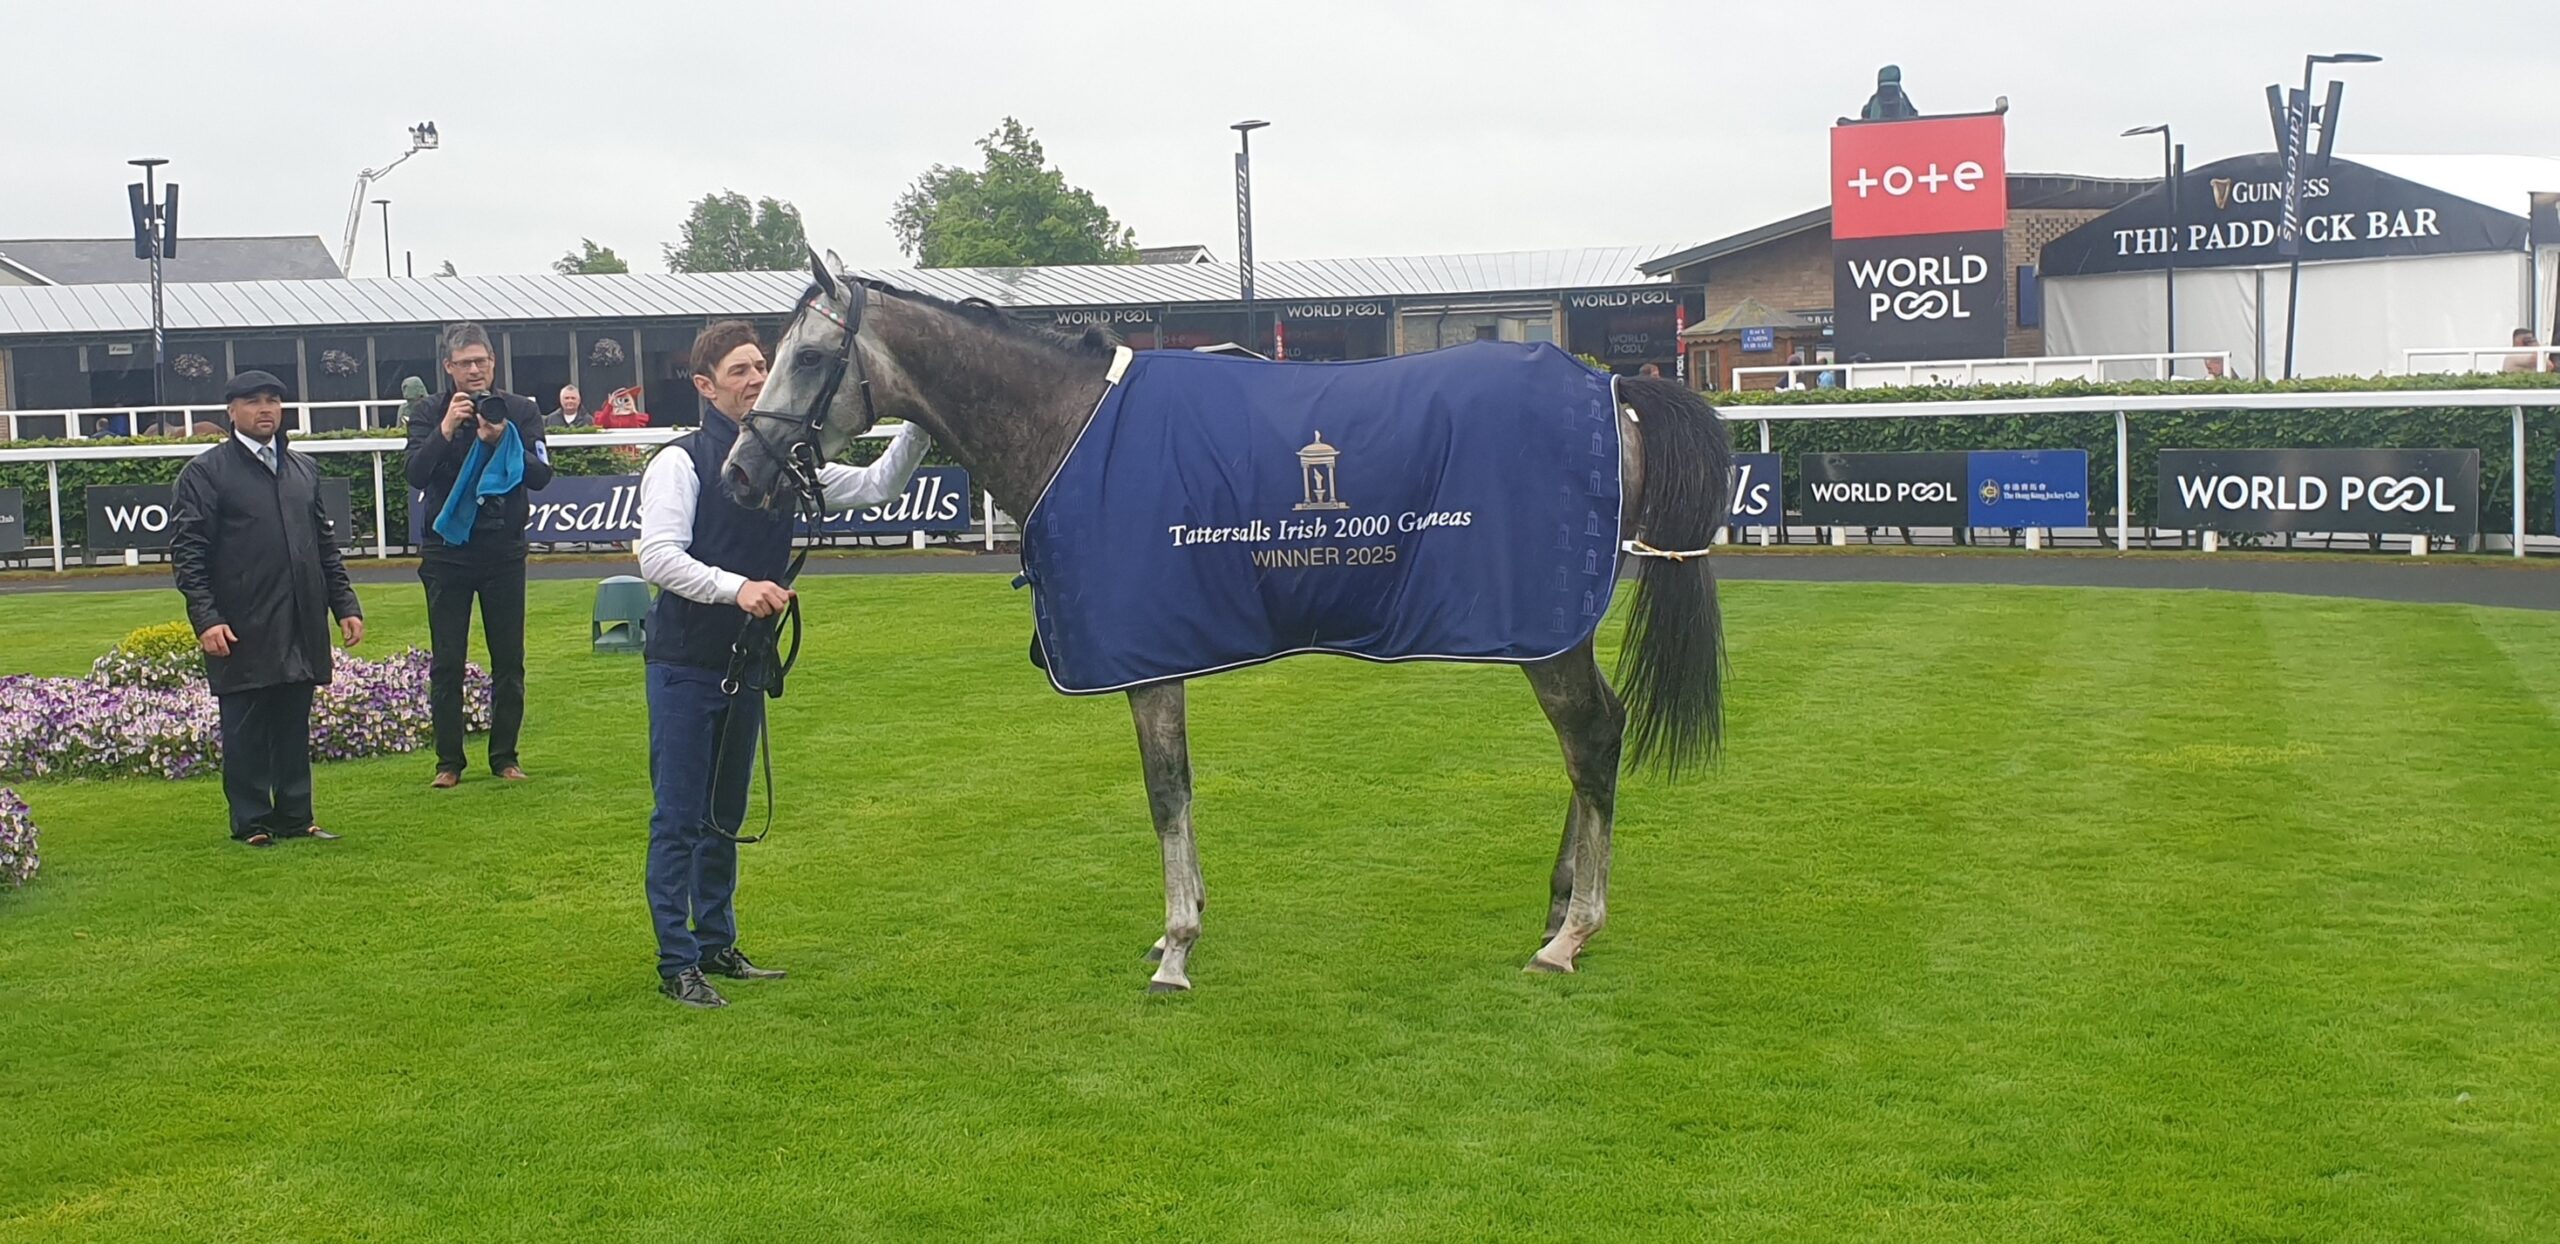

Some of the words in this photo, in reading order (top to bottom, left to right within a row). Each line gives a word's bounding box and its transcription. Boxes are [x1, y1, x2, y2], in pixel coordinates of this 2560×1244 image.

[2283, 102, 2304, 241] Tattersalls
[2232, 178, 2330, 203] GUINSS
[1238, 165, 1251, 288] Tattersalls
[2113, 226, 2178, 255] THE
[2187, 213, 2355, 251] PADDCK
[2366, 208, 2441, 239] BAR
[1848, 254, 1988, 289] WORLD
[1287, 304, 1341, 318] WORLD
[1346, 303, 1385, 316] POOL
[1571, 293, 1627, 308] WORLD
[1632, 290, 1673, 305] POOL
[1869, 289, 1971, 322] POOL
[1057, 311, 1110, 325] WORLD
[1114, 309, 1152, 323] POOL
[1811, 483, 1891, 502] WORLD
[1899, 482, 1957, 501] POOL
[2177, 475, 2328, 511] WORLD
[2341, 476, 2456, 513] POOL
[1168, 519, 1271, 546] Tattersalls
[1278, 517, 1327, 540] Irish
[1334, 514, 1390, 538] 2000
[1397, 510, 1472, 532] Guneas
[1251, 547, 1340, 568] WINNER
[1345, 545, 1397, 565] 2025
